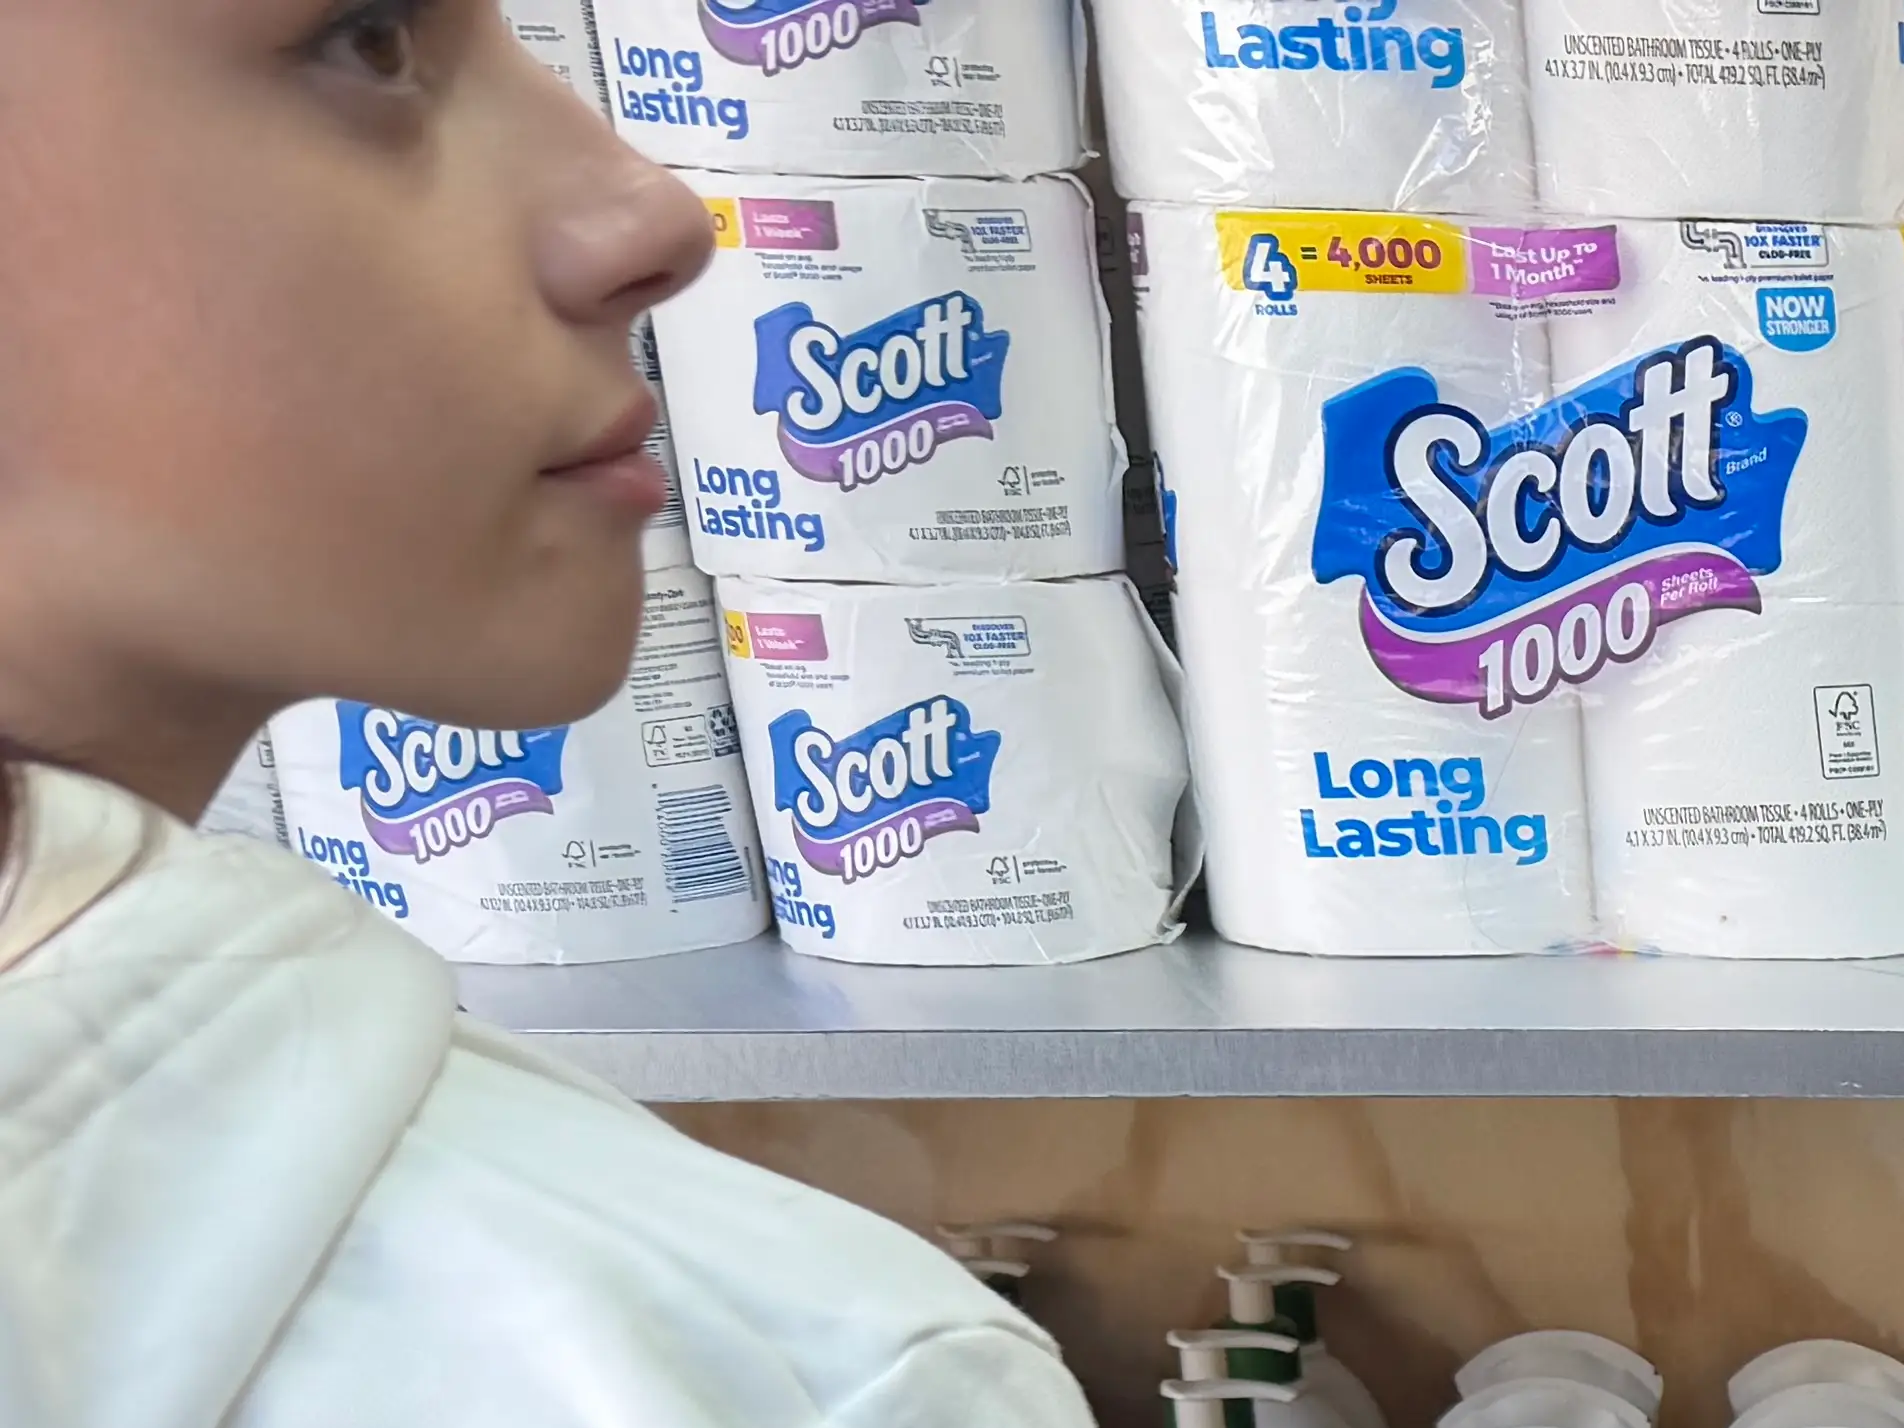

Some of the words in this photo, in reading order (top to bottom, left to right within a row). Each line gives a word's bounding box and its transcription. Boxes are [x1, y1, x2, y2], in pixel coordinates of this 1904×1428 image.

[615, 38, 702, 90] Long
[761, 2, 858, 70] 1000
[1200, 6, 1466, 88] Lasting
[616, 81, 749, 140] Lasting
[1246, 238, 1296, 297] 4
[1327, 236, 1442, 271] 4,000
[1365, 274, 1413, 285] SHEETS
[1491, 242, 1537, 264] Last
[1541, 245, 1570, 266] Up
[1574, 242, 1598, 257] To
[1255, 304, 1298, 316] ROLLS
[1766, 296, 1824, 318] NOW
[1767, 320, 1829, 336] STRONGER
[786, 295, 971, 430] Scott
[694, 458, 779, 507] Long
[839, 420, 932, 487] 1000
[1384, 344, 1728, 608] Scott
[1726, 449, 1766, 475] Brand
[695, 497, 825, 551] Lasting
[1479, 583, 1650, 710] 1000
[794, 700, 956, 827] Scott
[1313, 751, 1485, 809] Long
[298, 828, 369, 875] Long
[410, 797, 490, 861] 1000
[841, 818, 921, 880] 1000
[1300, 802, 1547, 866] Lasting
